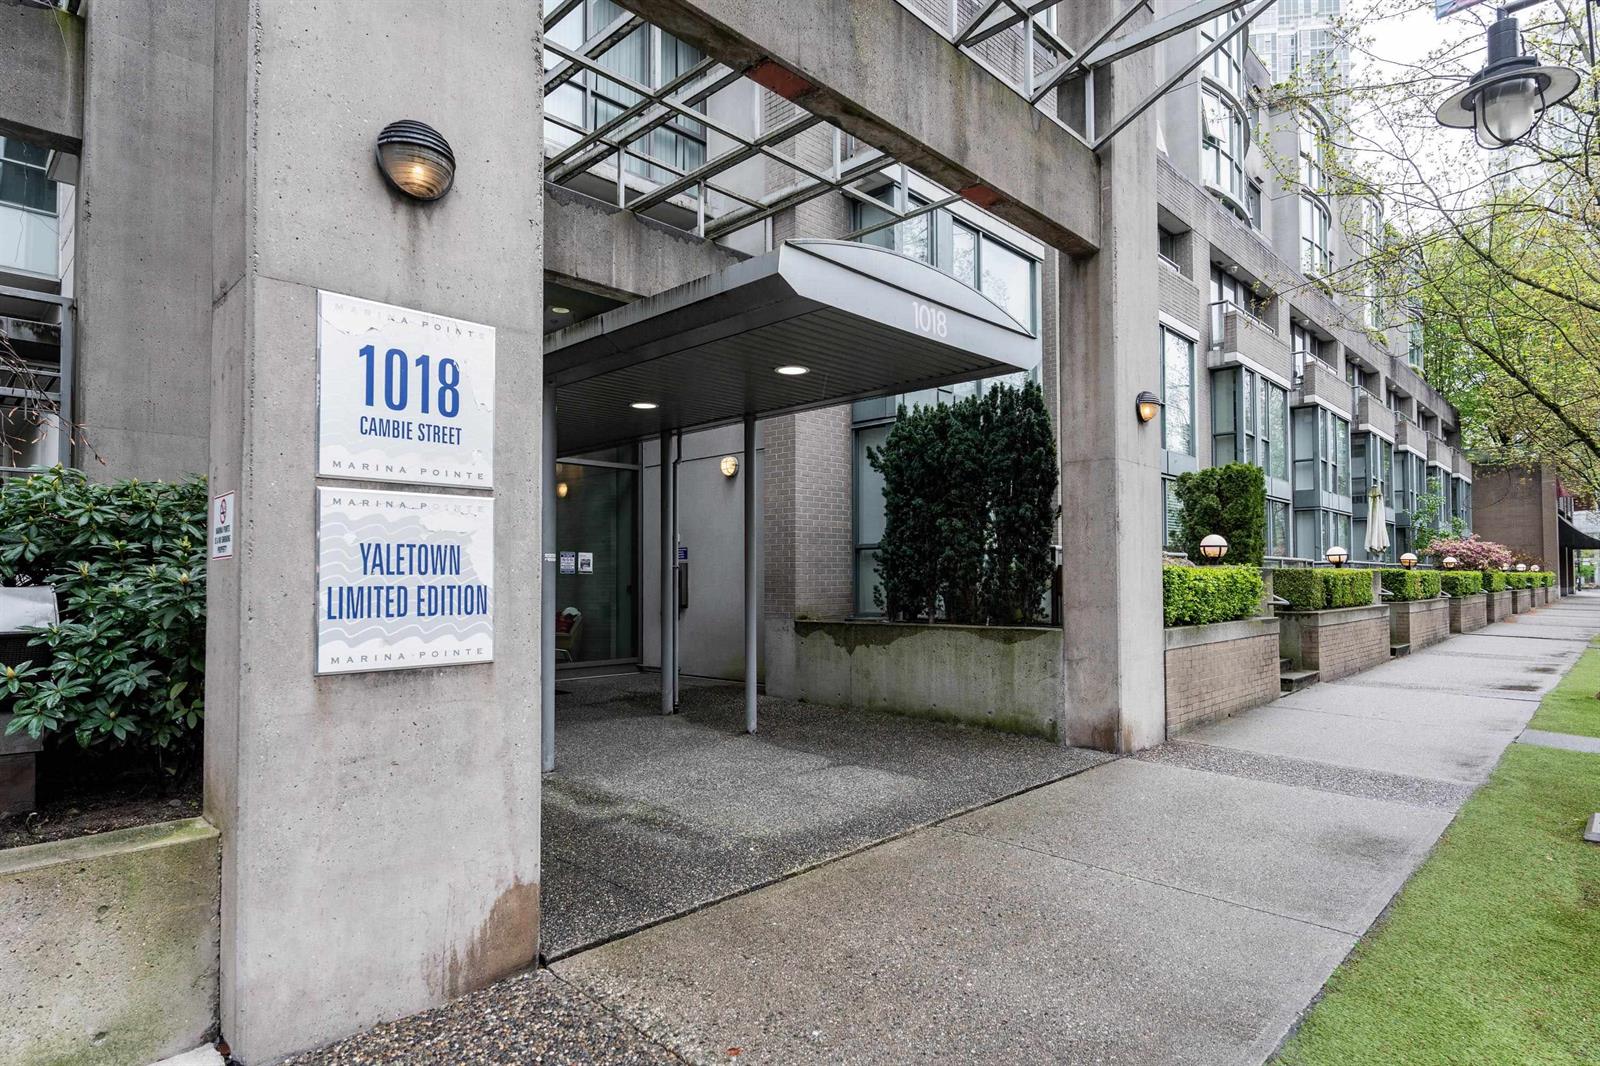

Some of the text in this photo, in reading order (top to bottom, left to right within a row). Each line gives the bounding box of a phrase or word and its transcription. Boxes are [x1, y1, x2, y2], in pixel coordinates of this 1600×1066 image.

[912, 301, 947, 338] 1018
[359, 344, 460, 418] 1018
[360, 415, 462, 445] CAMBIE STREET
[332, 460, 484, 480] MARINA POINTE
[332, 497, 406, 509] MARINA
[359, 542, 461, 576] YALETOWN
[327, 584, 488, 620] LIMITED EDITION
[330, 647, 484, 665] MARINA POINTE
